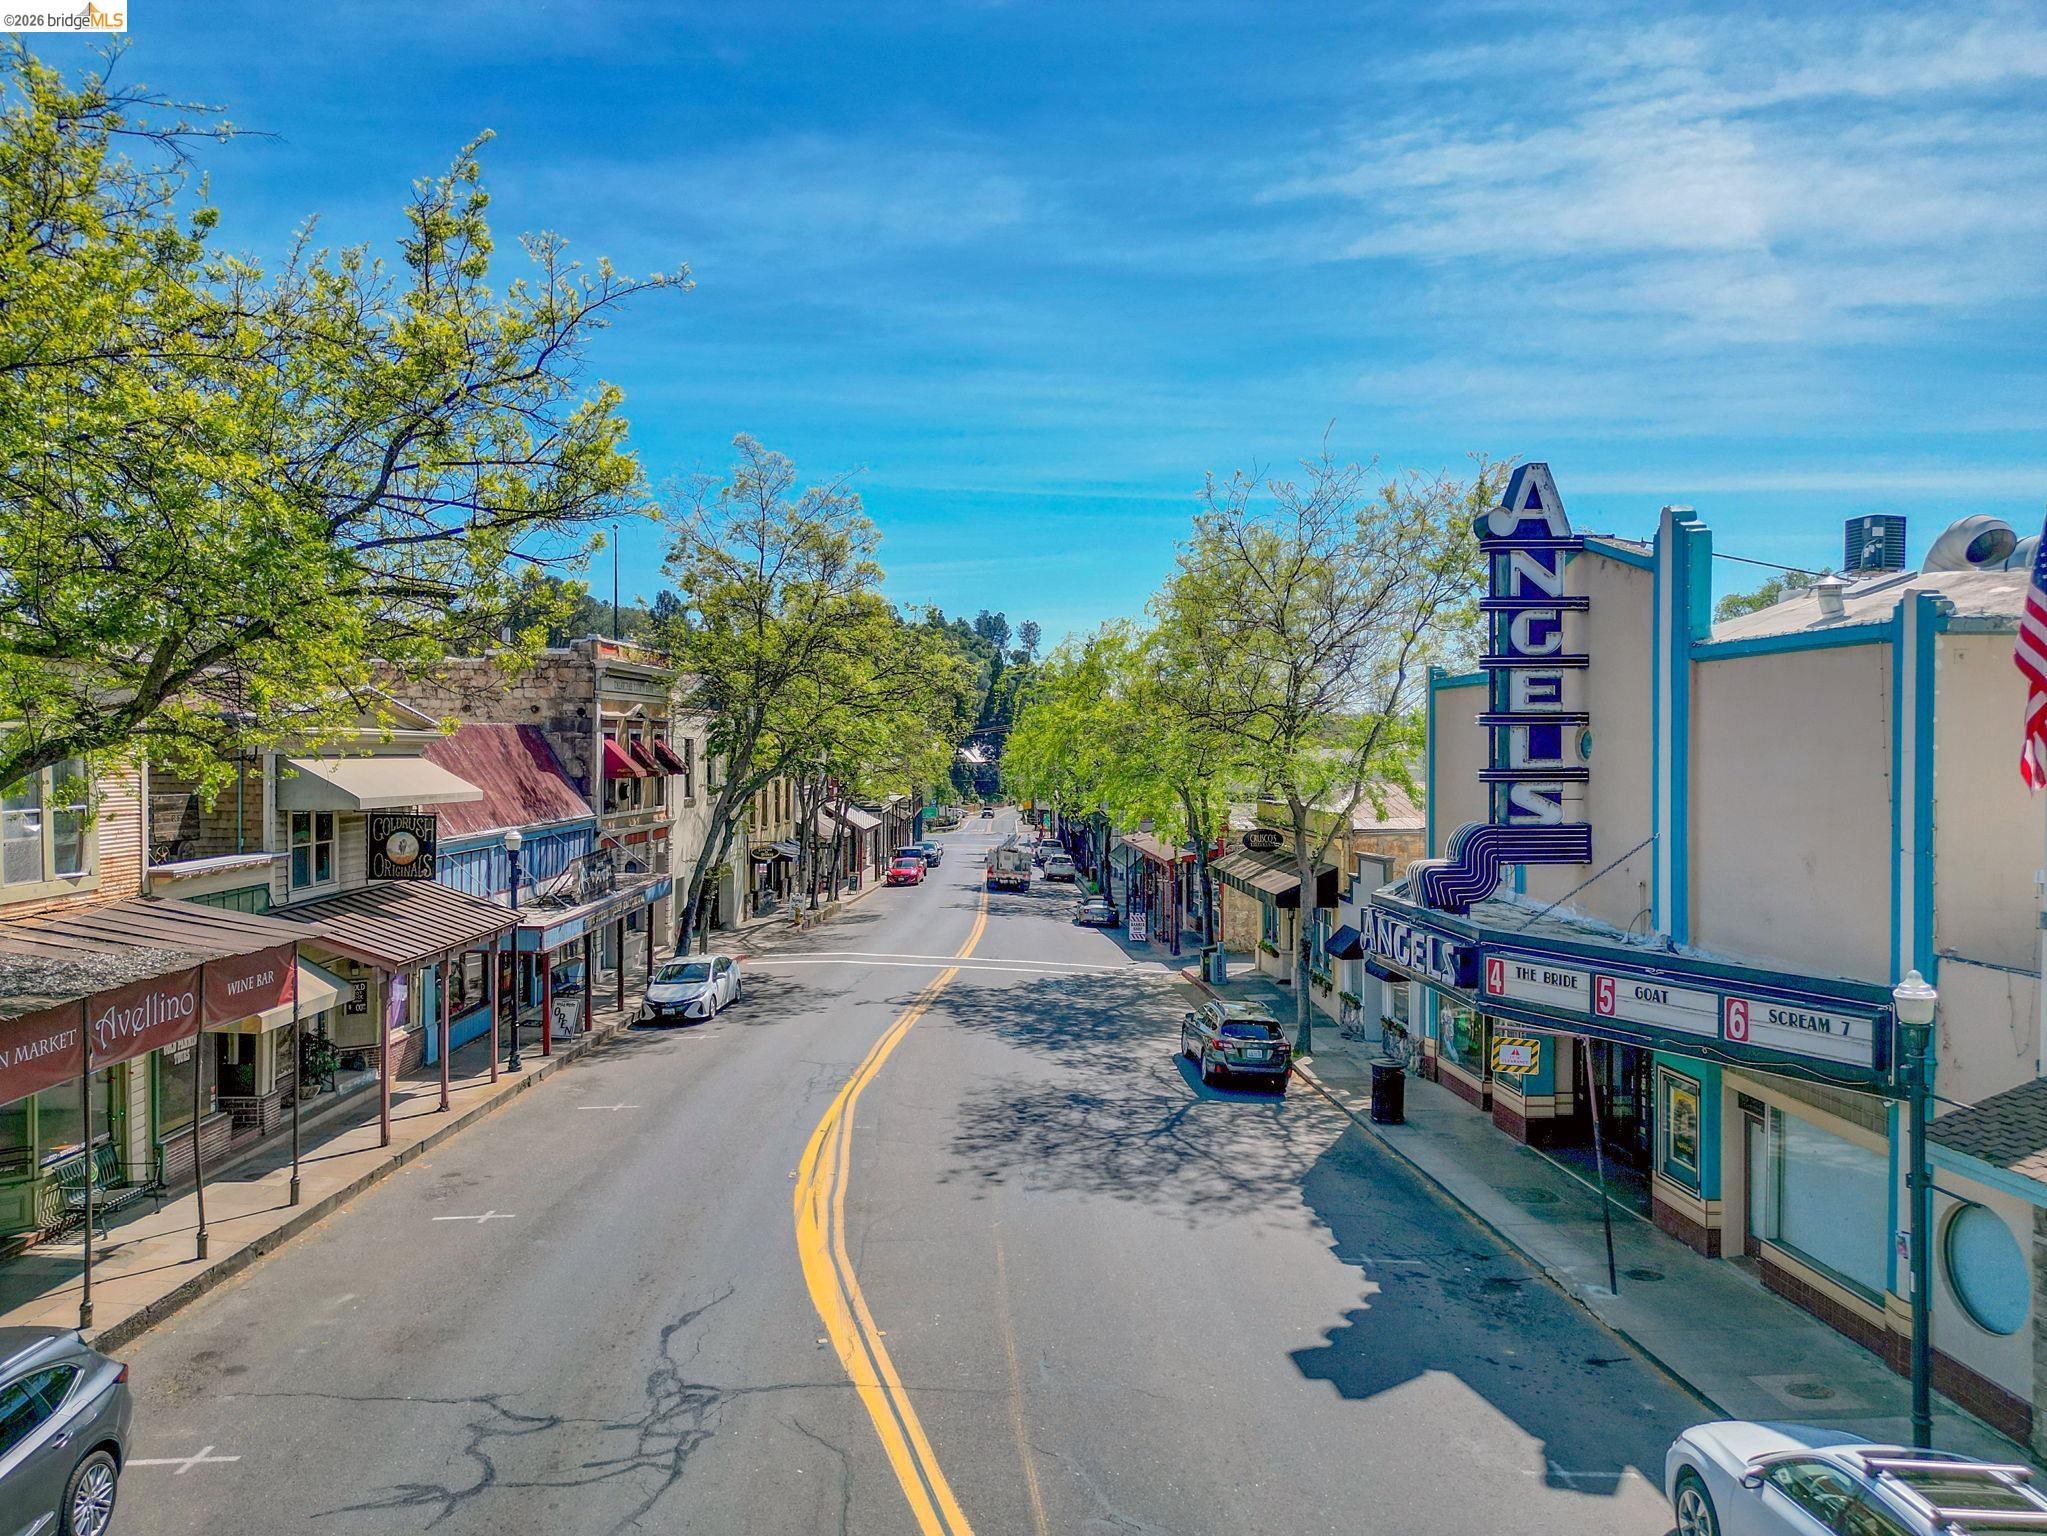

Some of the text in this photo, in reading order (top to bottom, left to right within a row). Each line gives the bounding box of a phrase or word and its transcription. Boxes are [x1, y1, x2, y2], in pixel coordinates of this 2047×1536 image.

[1485, 463, 1574, 826] ANGELS
[372, 816, 435, 842] GOLDRUSH
[373, 852, 433, 878] ORIGINALS
[1360, 906, 1456, 987] ANGELS
[227, 970, 275, 996] WINE BAR
[1489, 960, 1578, 993] 4 THE BRIDE
[1600, 978, 1669, 1014] 5 GOAT
[95, 991, 195, 1051] Avellino
[553, 1006, 573, 1037] OPEN
[1729, 1001, 1850, 1039] 6 SCREAM 7
[14, 1029, 77, 1065] MARKET
